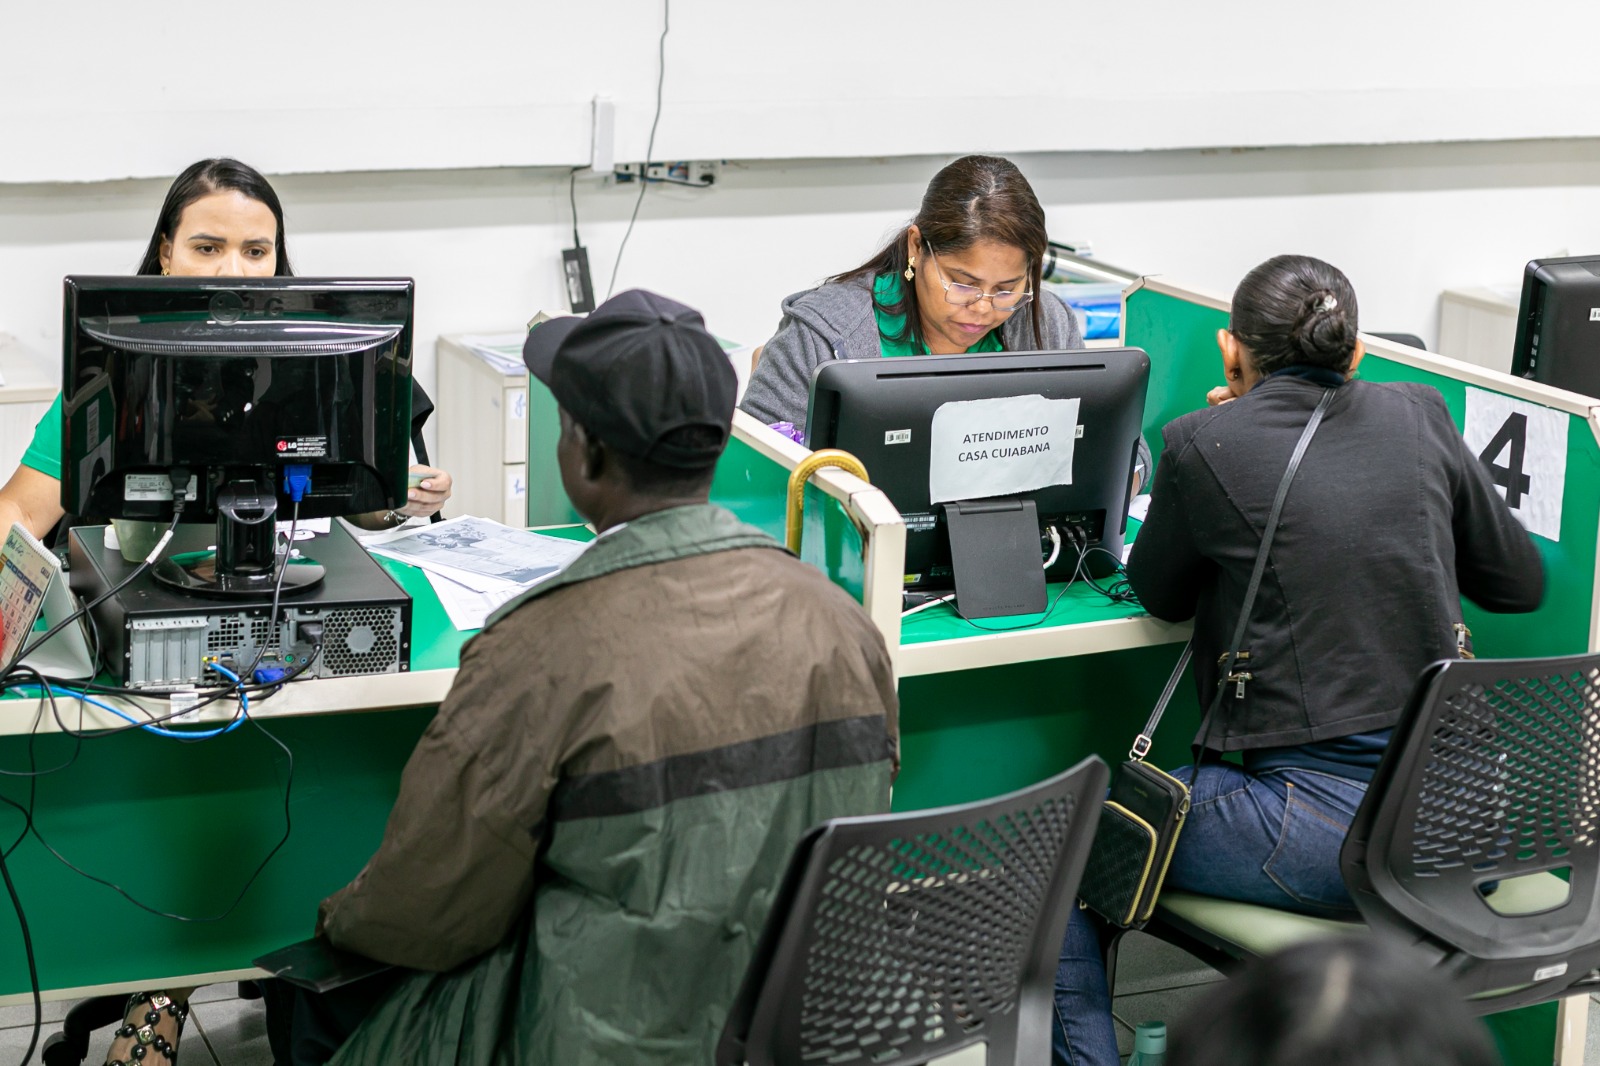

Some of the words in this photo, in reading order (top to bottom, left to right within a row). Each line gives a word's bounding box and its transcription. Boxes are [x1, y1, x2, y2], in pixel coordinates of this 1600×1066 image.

[962, 425, 1049, 444] ATENDIMENTO
[287, 441, 297, 449] LG
[958, 450, 988, 462] CASA
[991, 441, 1051, 459] CUIABANA
[1479, 412, 1531, 510] 4
